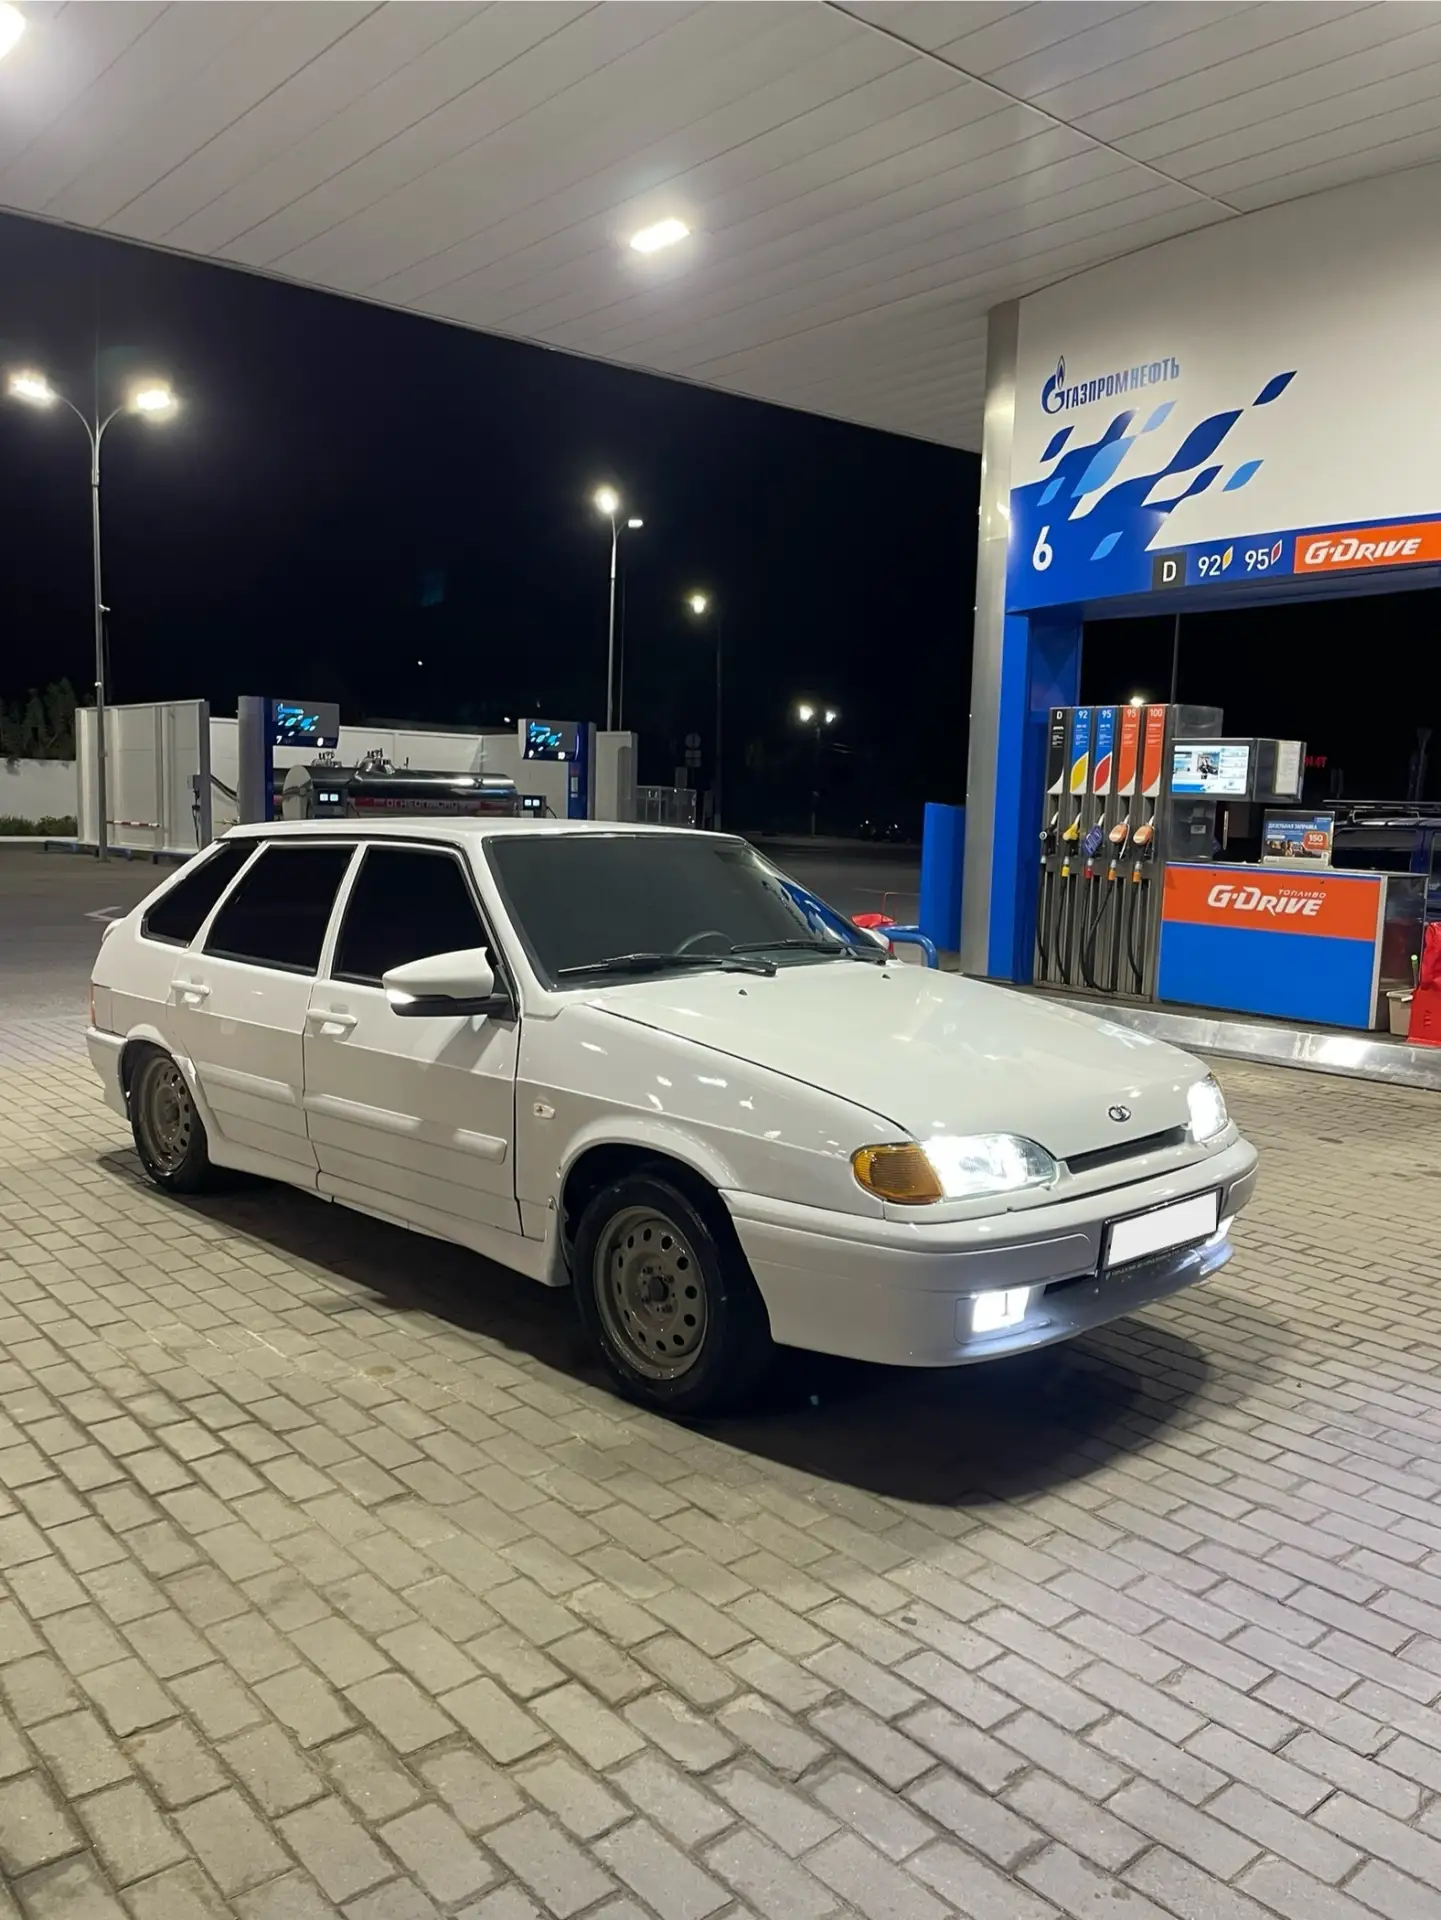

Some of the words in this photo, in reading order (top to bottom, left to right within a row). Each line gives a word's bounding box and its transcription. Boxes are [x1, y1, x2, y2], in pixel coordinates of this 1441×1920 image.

[1065, 357, 1180, 410] ГАЗПРОМНЕФТЬ
[1032, 525, 1053, 571] 6
[1198, 554, 1221, 577] 92
[1244, 549, 1269, 571] 95
[1162, 561, 1177, 582] D
[1056, 710, 1063, 720] D
[1078, 710, 1088, 719] 92
[1102, 710, 1112, 719] 95
[1127, 709, 1137, 718] 95
[1150, 708, 1163, 717] 100
[1308, 833, 1324, 842] 150
[1278, 888, 1327, 900] ТОПЛИВО
